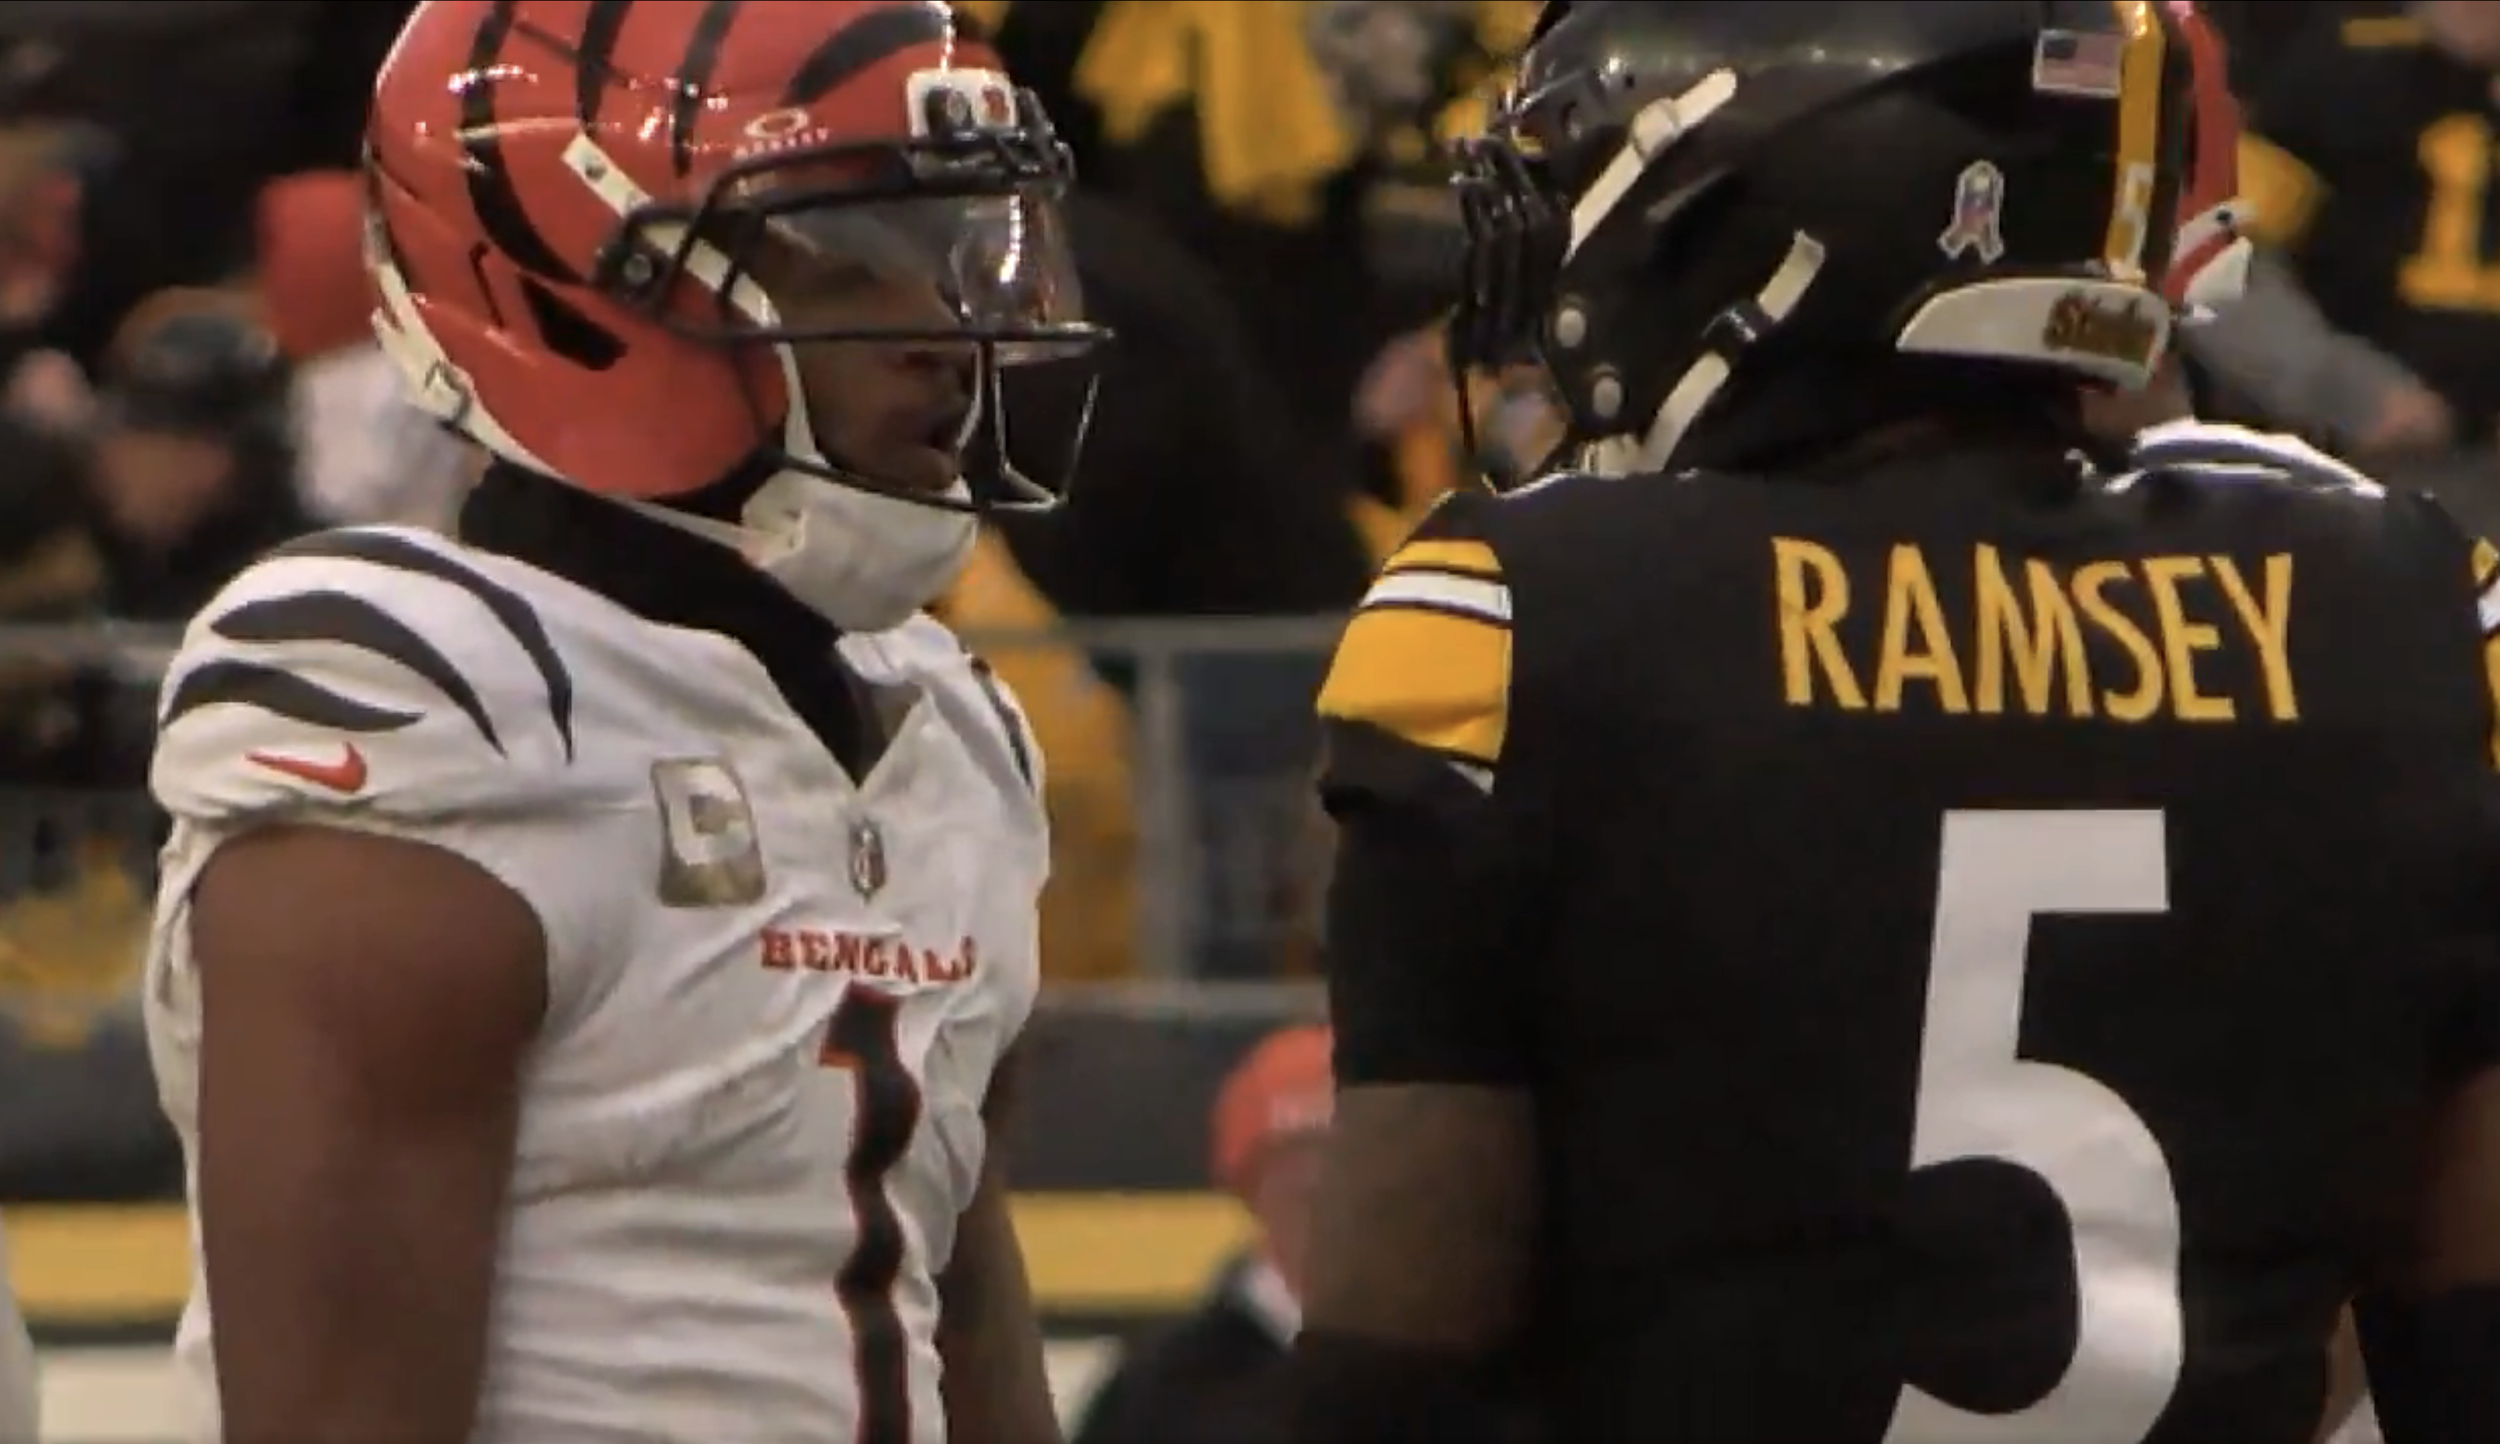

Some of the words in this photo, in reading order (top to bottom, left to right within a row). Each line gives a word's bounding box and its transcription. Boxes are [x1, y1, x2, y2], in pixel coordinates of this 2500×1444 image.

[1771, 536, 2298, 722] RAMSEY
[816, 978, 924, 1444] 1
[1880, 808, 2185, 1444] 5
